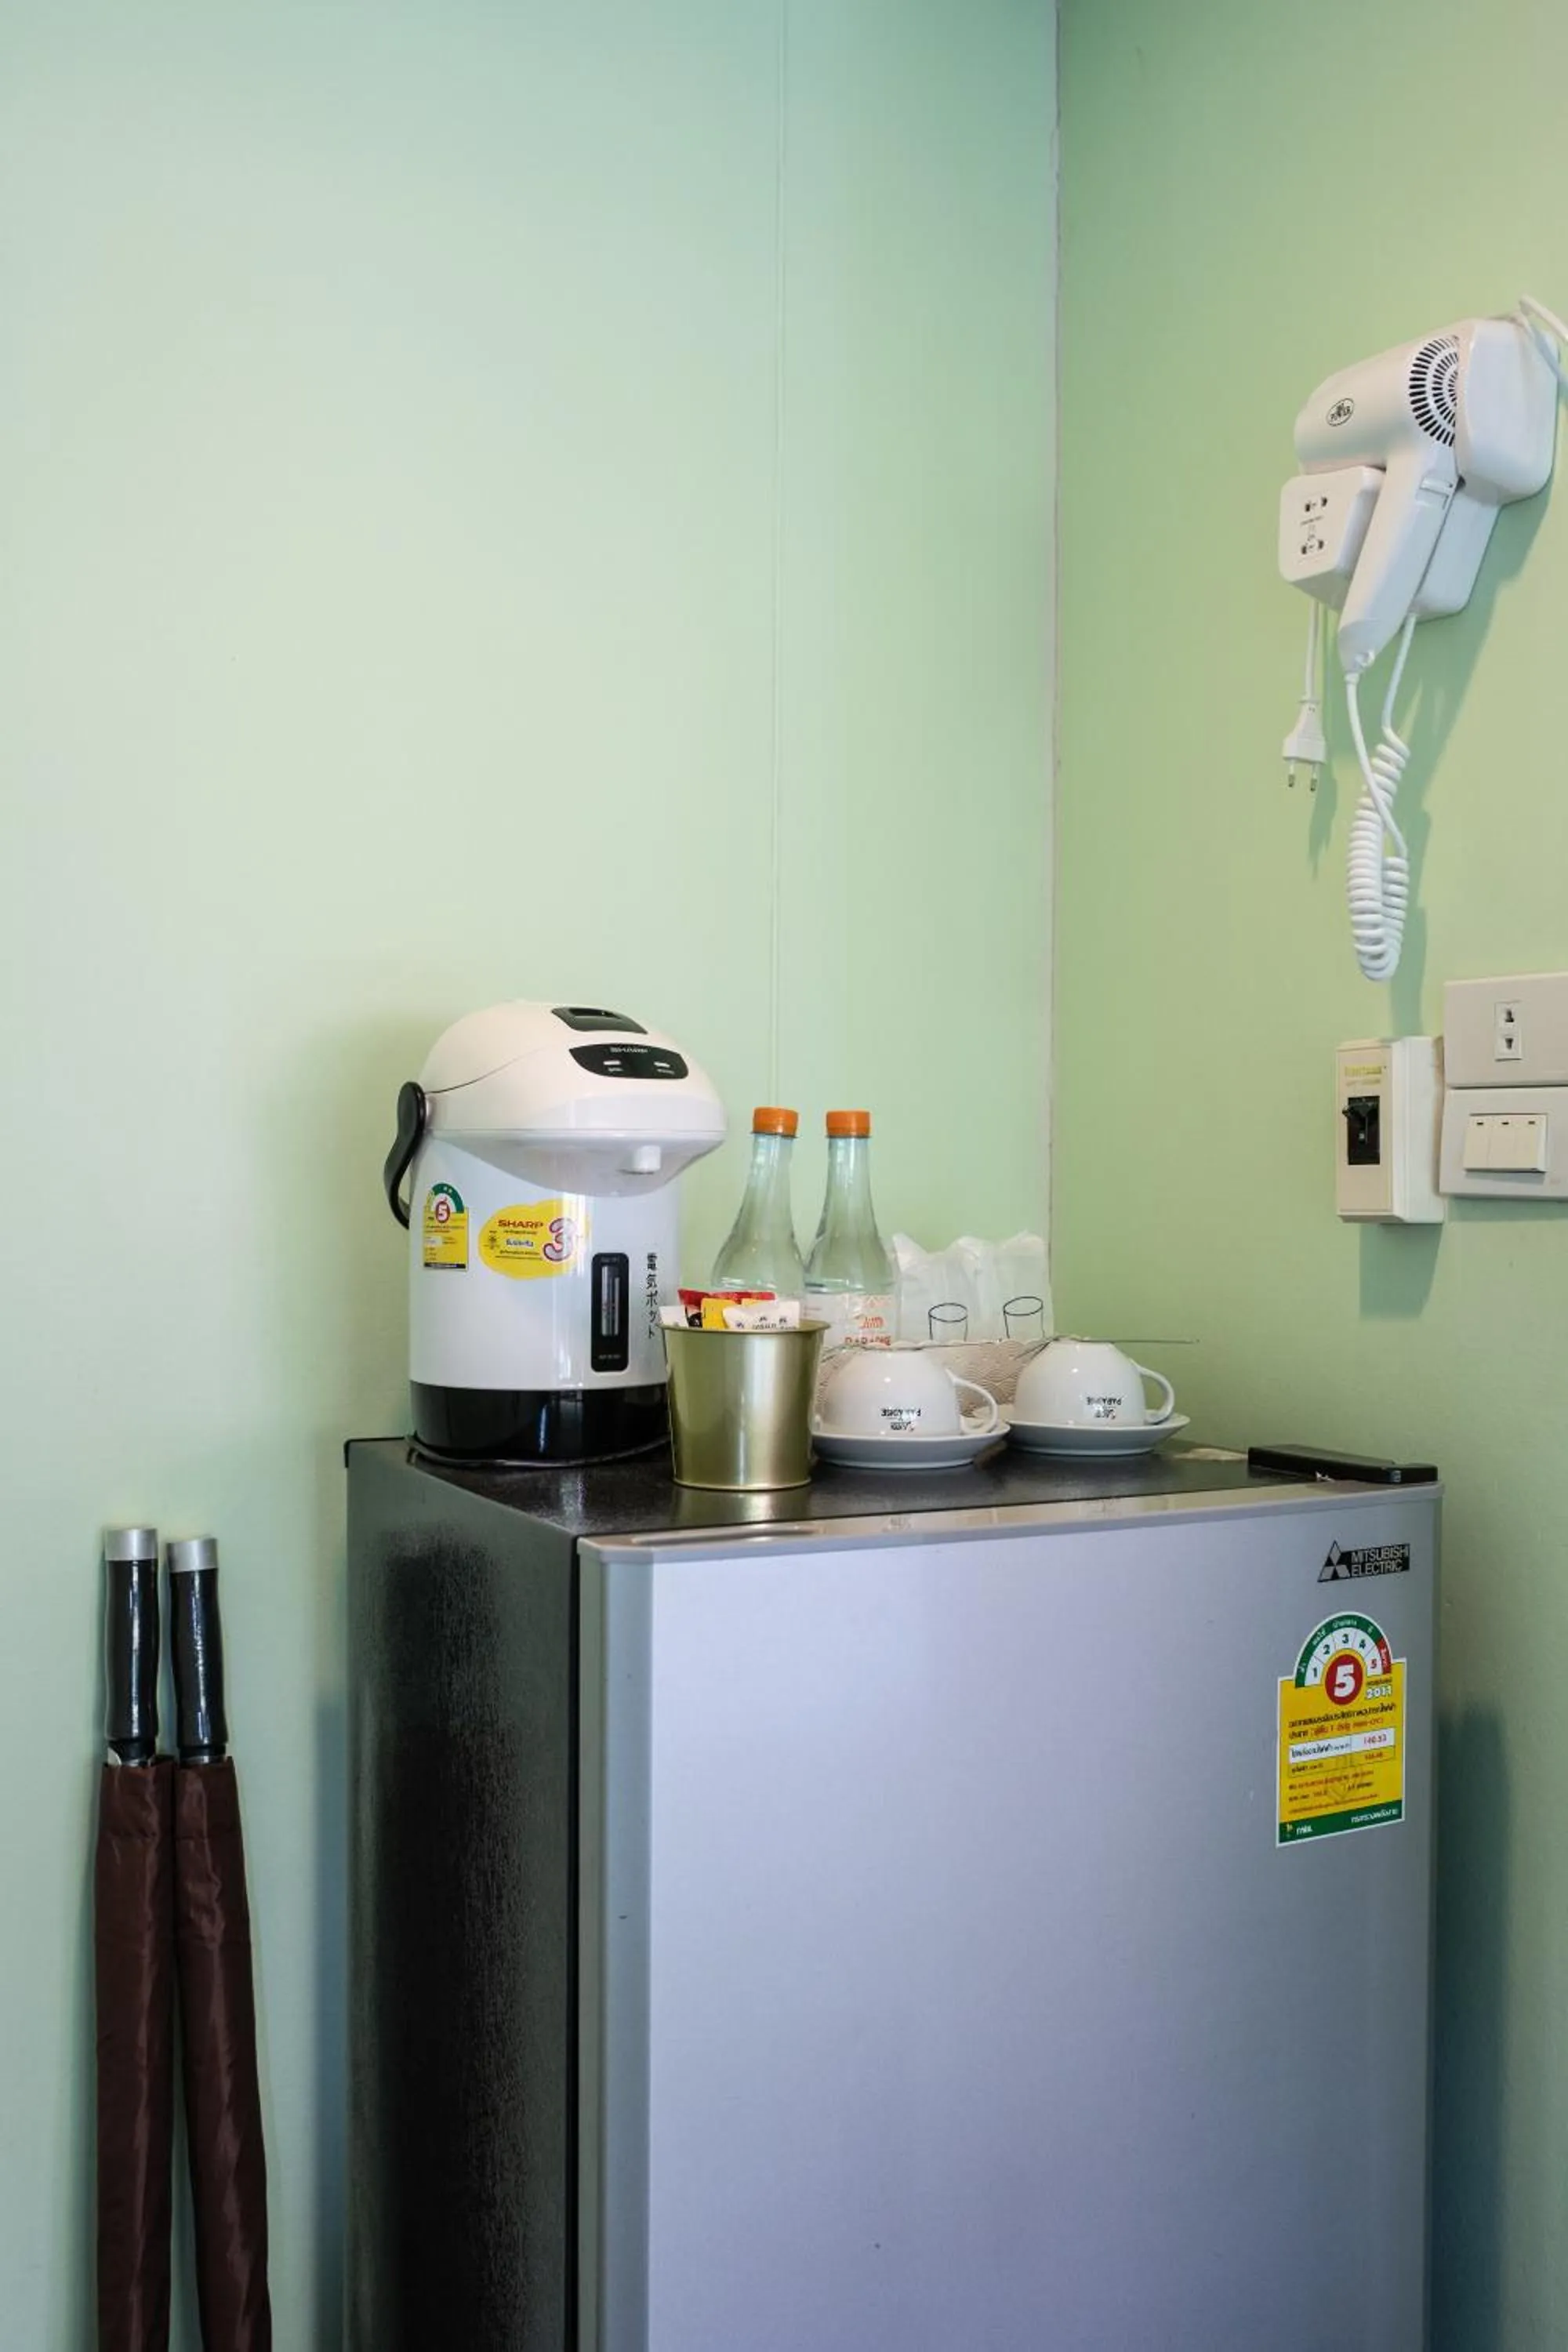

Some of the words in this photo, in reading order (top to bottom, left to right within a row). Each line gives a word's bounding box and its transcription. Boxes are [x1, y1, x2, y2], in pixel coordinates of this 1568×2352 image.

[497, 1219, 544, 1229] SHARP
[543, 1217, 575, 1261] 3
[1086, 1396, 1122, 1406] PARAE
[1351, 1544, 1410, 1563] MITSUBISHI
[1351, 1559, 1403, 1577] ELECTRIC
[1341, 1633, 1349, 1644] 3
[1323, 1643, 1330, 1655] 2
[1359, 1639, 1367, 1650] 4
[1370, 1658, 1377, 1669] 5
[1334, 1664, 1356, 1697] 5
